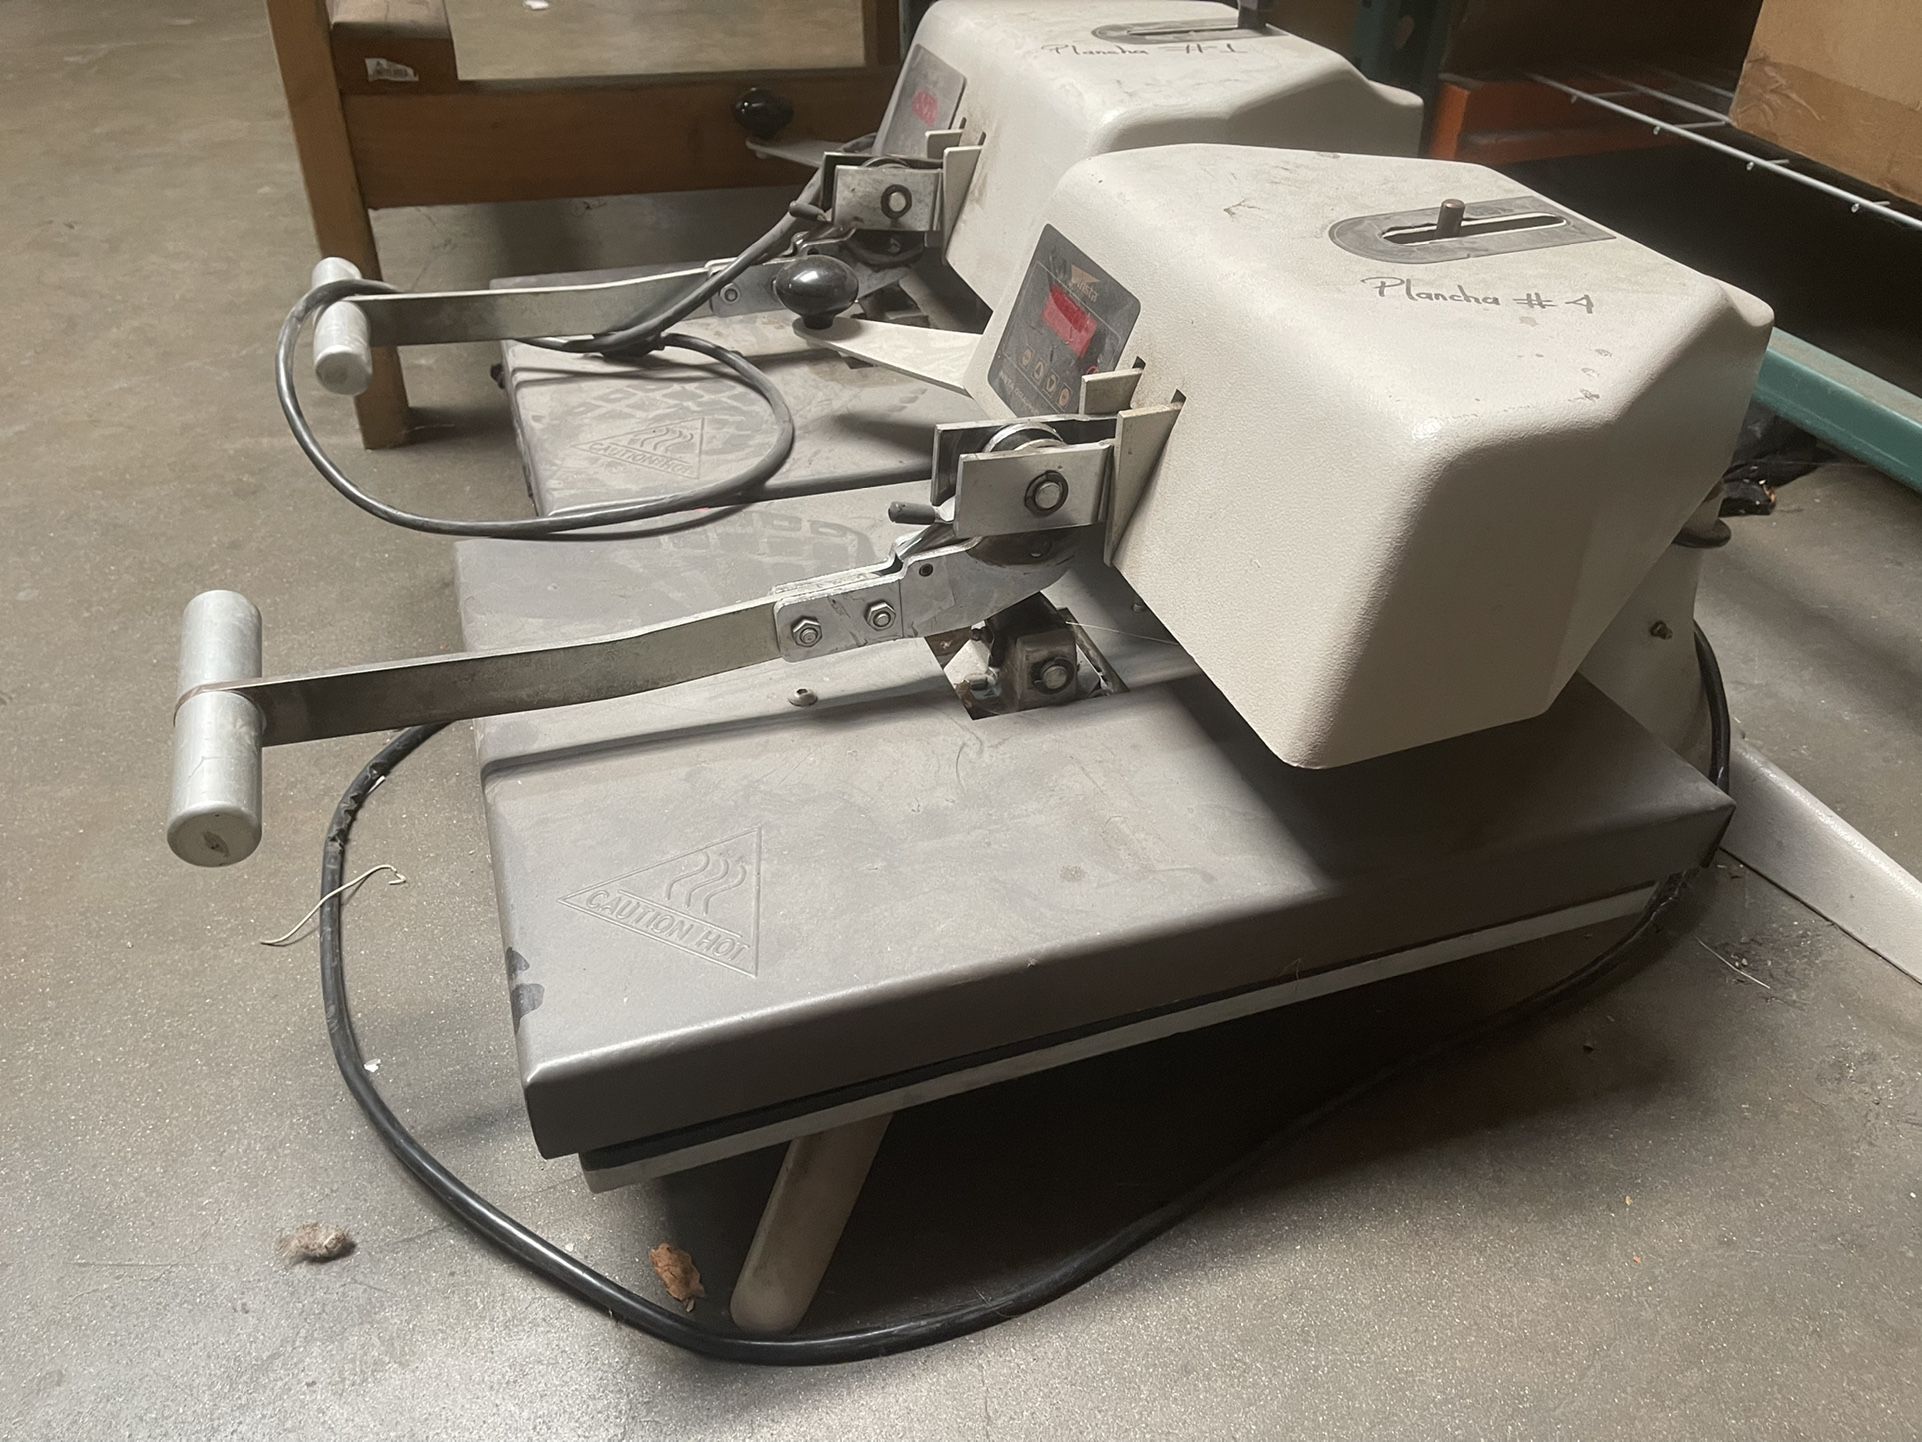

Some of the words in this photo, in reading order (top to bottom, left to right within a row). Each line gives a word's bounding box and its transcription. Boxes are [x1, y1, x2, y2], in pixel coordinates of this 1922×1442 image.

[1041, 43, 1149, 55] Plancha
[1360, 276, 1501, 306] Plancha
[589, 442, 659, 467] CAUTION
[585, 889, 693, 941] CAUTION
[694, 930, 747, 961] HOT
